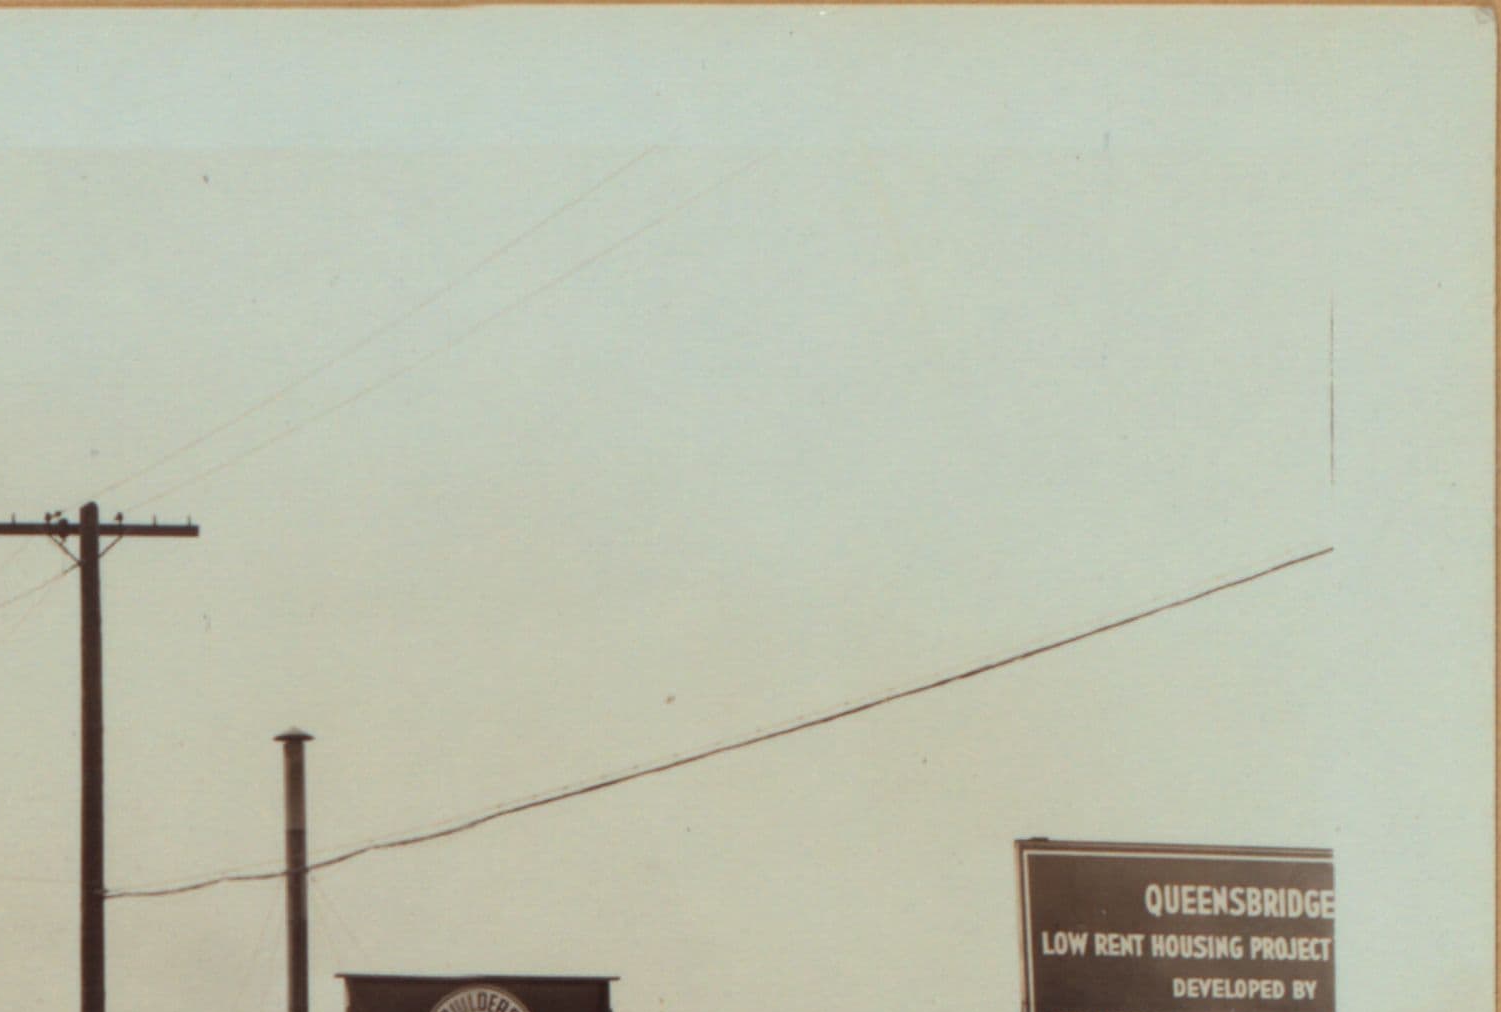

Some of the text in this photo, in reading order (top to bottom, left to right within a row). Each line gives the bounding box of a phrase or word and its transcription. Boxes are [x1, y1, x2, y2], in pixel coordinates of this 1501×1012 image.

[1145, 884, 1334, 919] QUEENSBRIDGE
[1041, 931, 1332, 961] LOW RENT HOUSING PROJECT
[1173, 977, 1317, 1001] DEVELOPED BY
